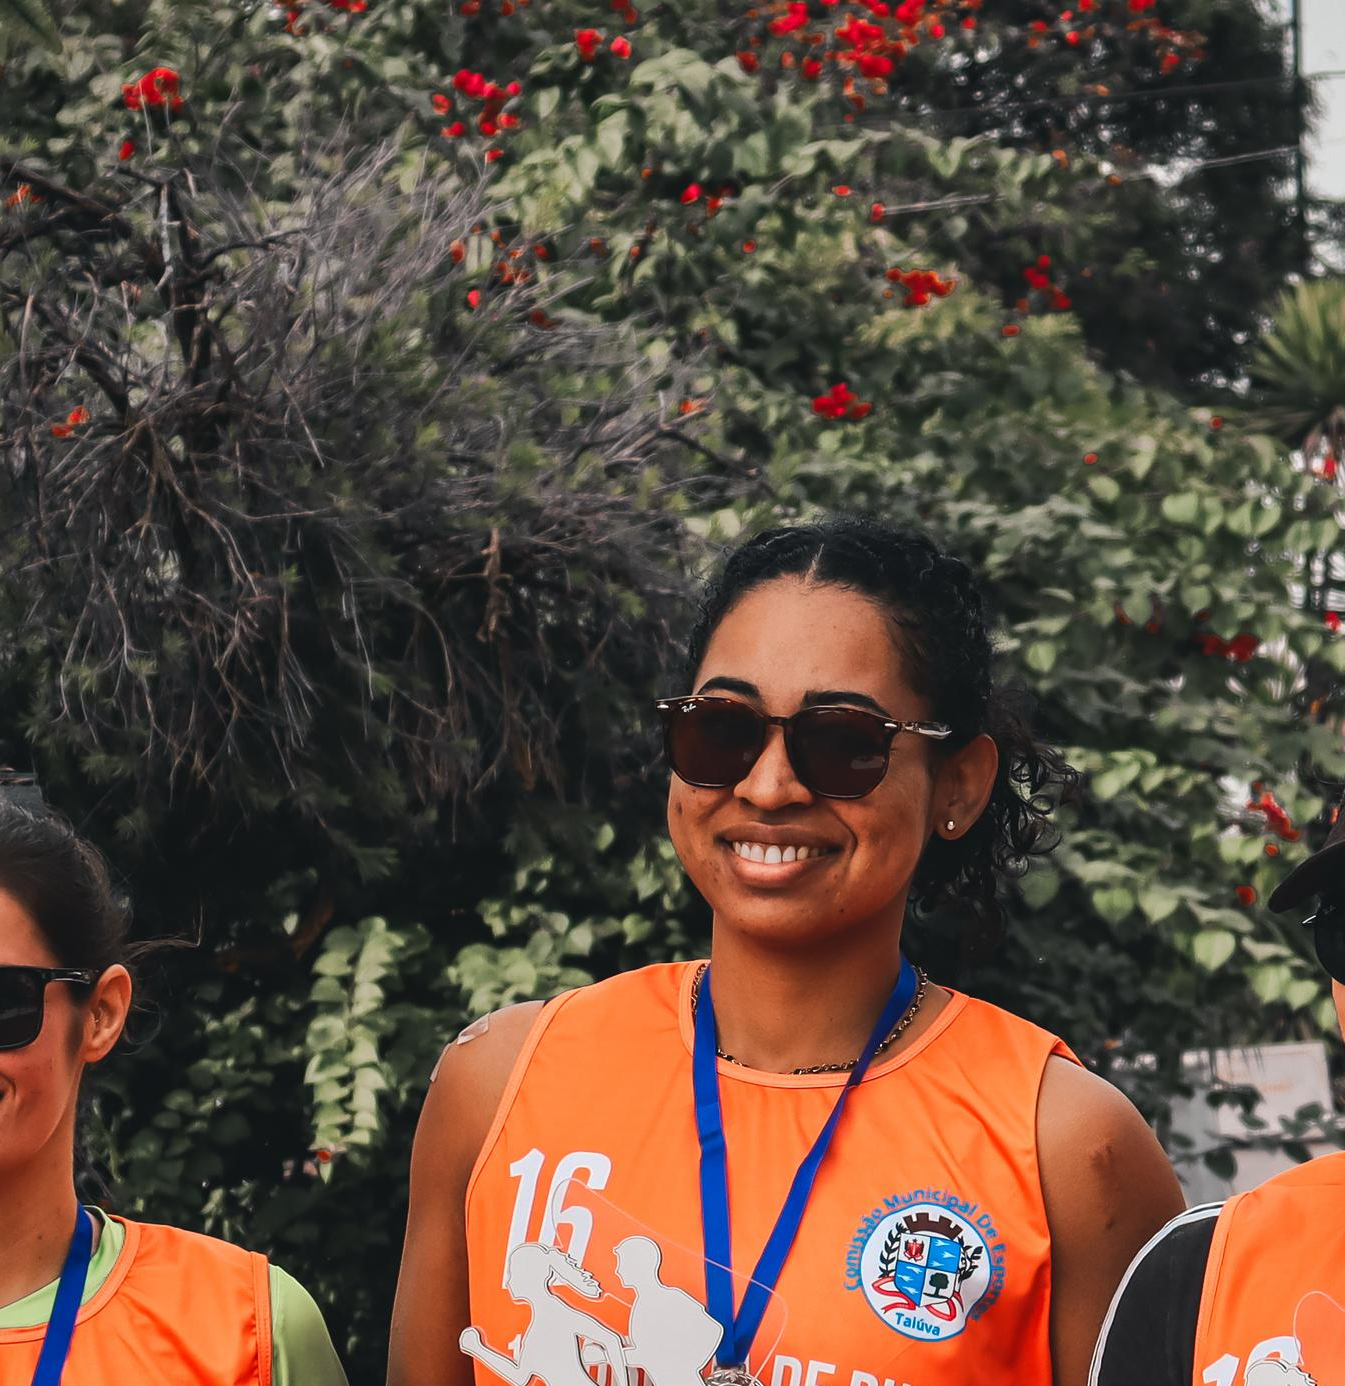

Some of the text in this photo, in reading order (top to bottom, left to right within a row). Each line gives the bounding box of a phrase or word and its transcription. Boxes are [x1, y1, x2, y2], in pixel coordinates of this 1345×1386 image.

[883, 1187, 978, 1216] Municipal
[502, 1148, 612, 1289] 16
[895, 1312, 941, 1337] Taiúva
